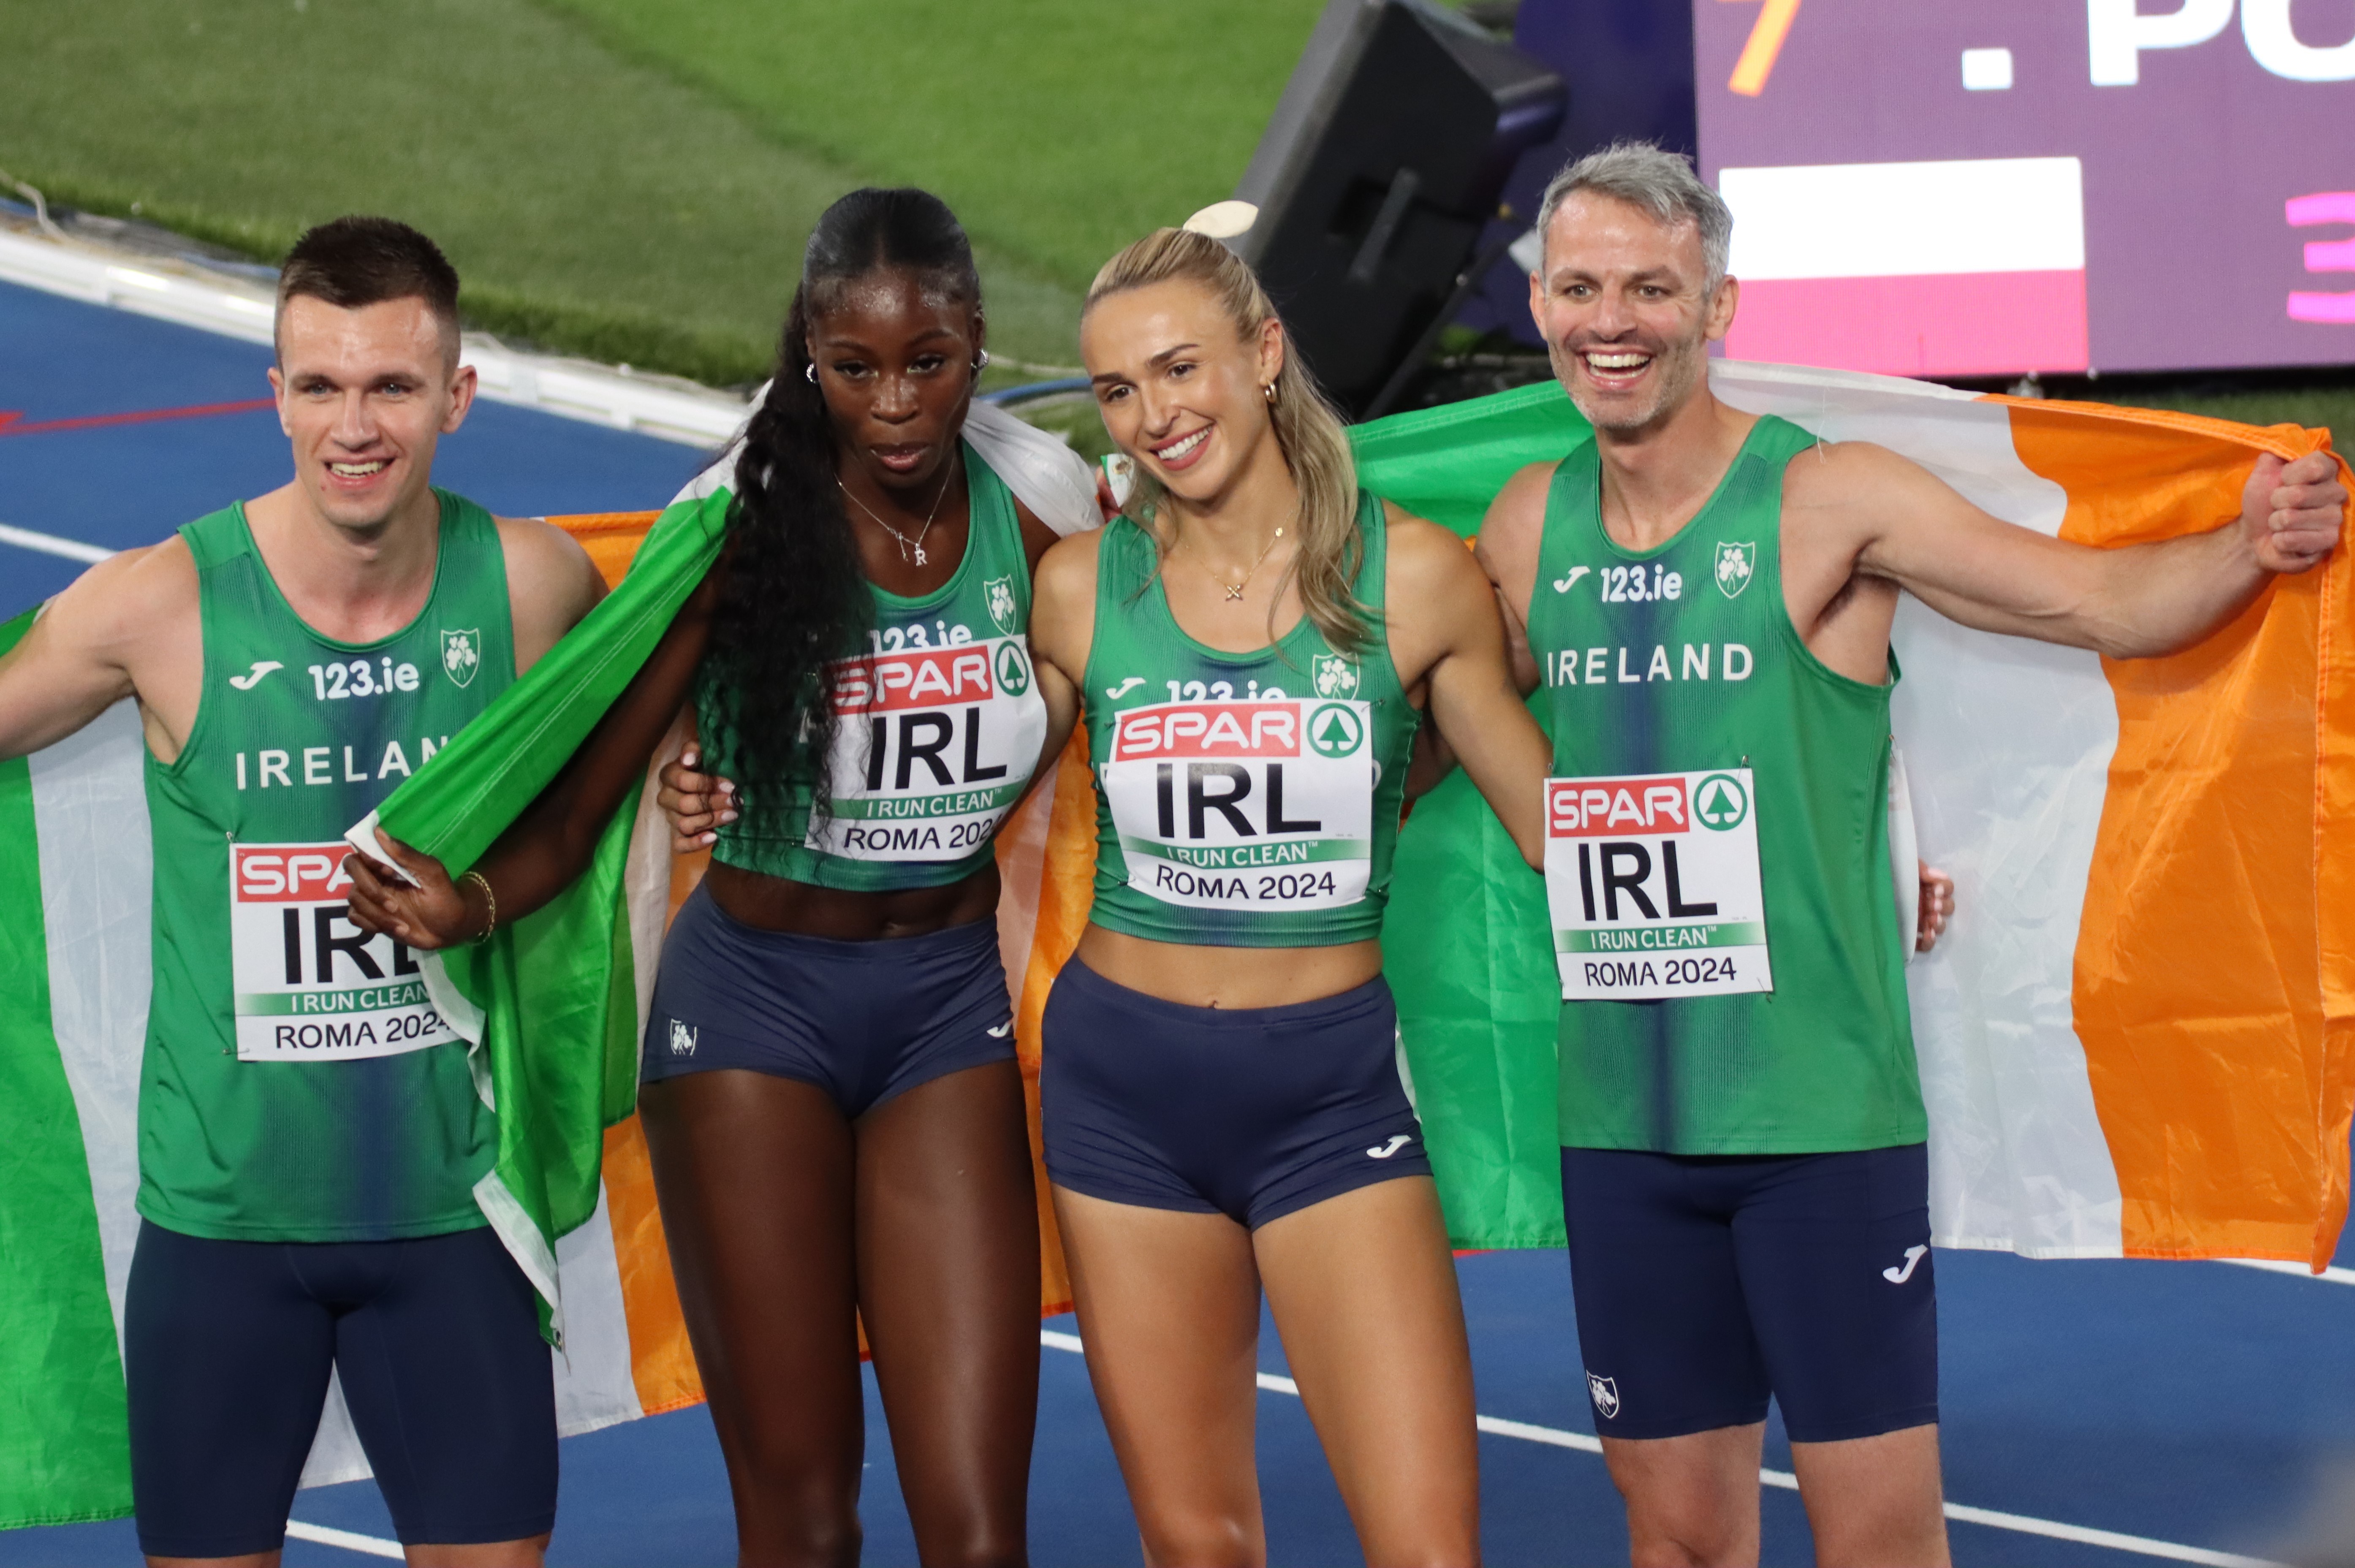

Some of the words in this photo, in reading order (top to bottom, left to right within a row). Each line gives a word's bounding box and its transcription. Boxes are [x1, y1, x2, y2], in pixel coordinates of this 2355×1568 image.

[1600, 564, 1682, 602] 123.ie
[308, 656, 419, 701] 123.ie
[834, 654, 989, 708] SPAR
[1547, 643, 1754, 688] IRELAND
[866, 707, 1007, 791] IRL
[1121, 711, 1295, 754] SPAR
[867, 801, 873, 817] I
[878, 799, 925, 817] RUN
[1157, 763, 1321, 838] IRL
[1553, 785, 1684, 830] SPAR
[844, 827, 941, 850] ROMA
[1167, 847, 1173, 859] I
[1177, 849, 1226, 867] RUN
[1156, 864, 1249, 899] ROMA
[1258, 871, 1336, 900] 2024
[1578, 840, 1718, 921] IRL
[1591, 932, 1596, 949] I
[1599, 930, 1637, 950] RUN
[1584, 961, 1658, 987] ROMA
[1665, 957, 1737, 985] 2024
[292, 996, 297, 1012] I
[304, 992, 354, 1012] RUN
[275, 1021, 378, 1049] ROMA
